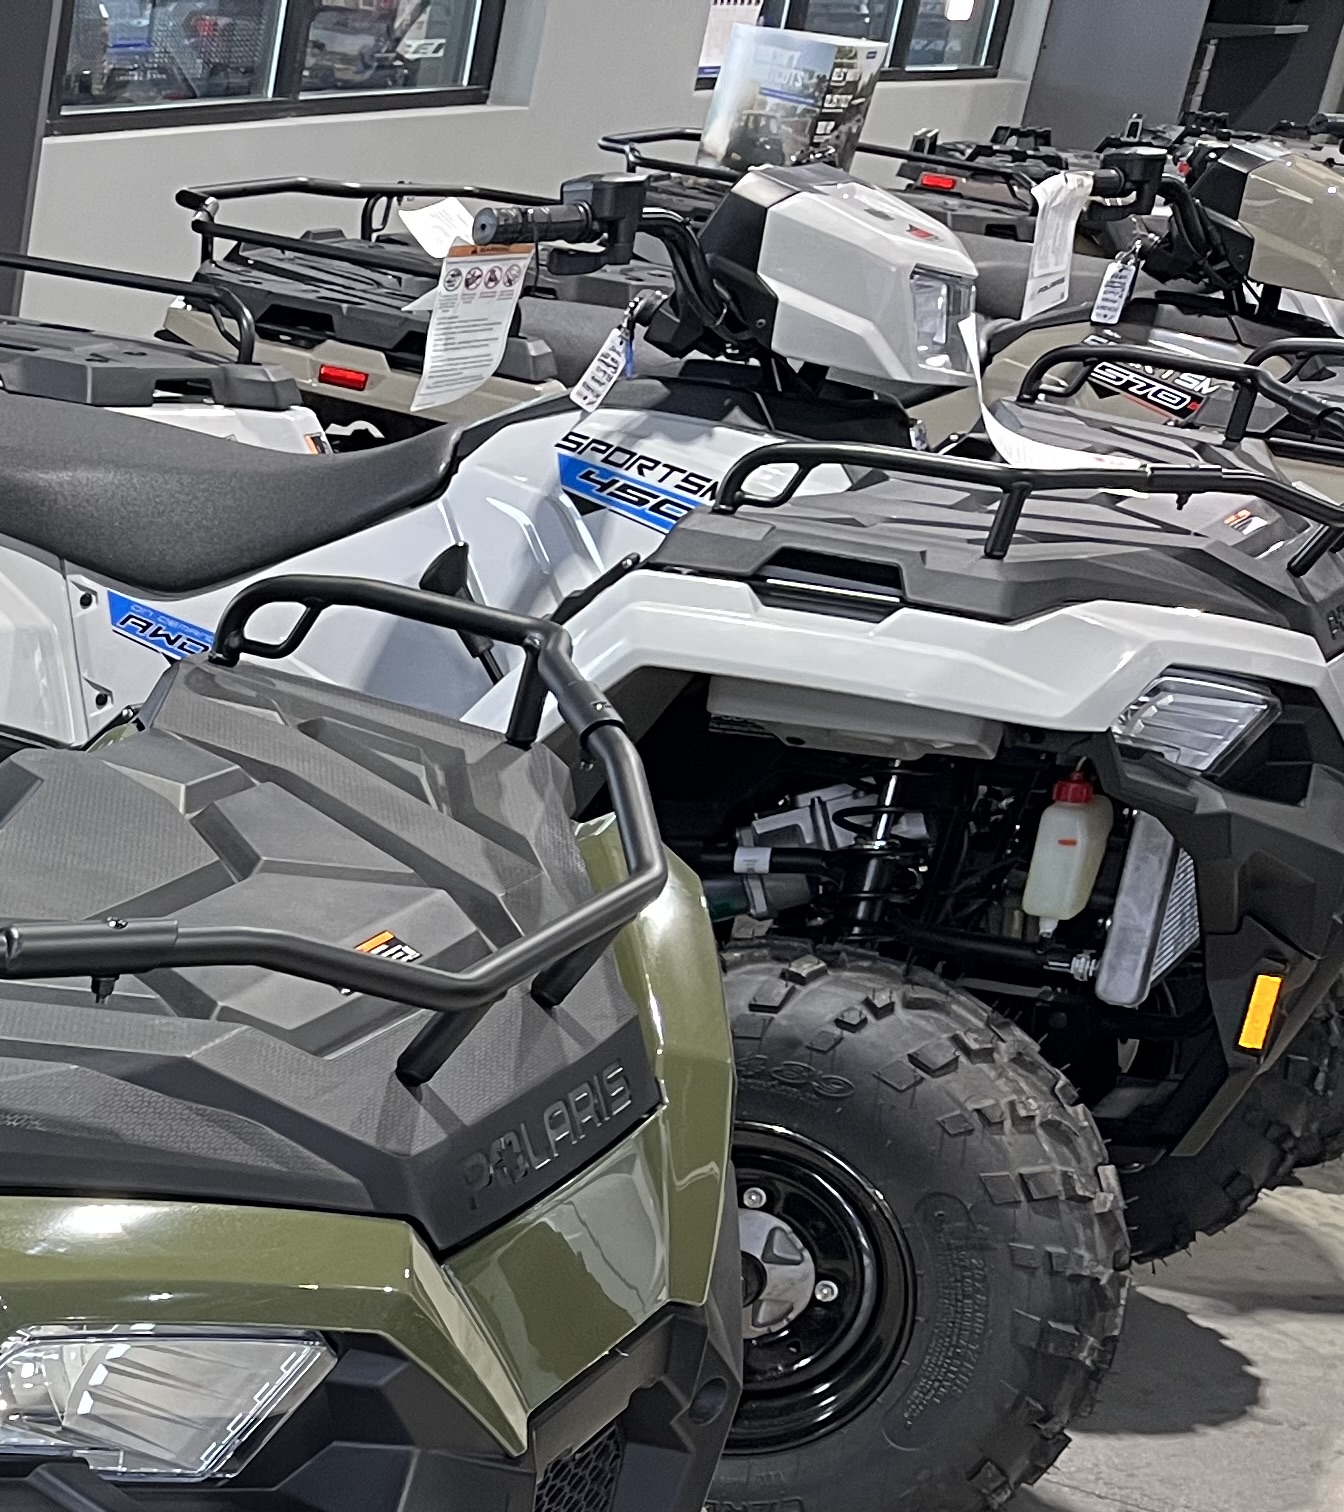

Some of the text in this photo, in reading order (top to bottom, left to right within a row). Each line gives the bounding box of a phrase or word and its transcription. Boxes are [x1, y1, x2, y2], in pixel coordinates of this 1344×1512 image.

[1090, 361, 1192, 410] 570
[116, 611, 213, 656] AWD
[460, 1061, 633, 1213] POLARIS
